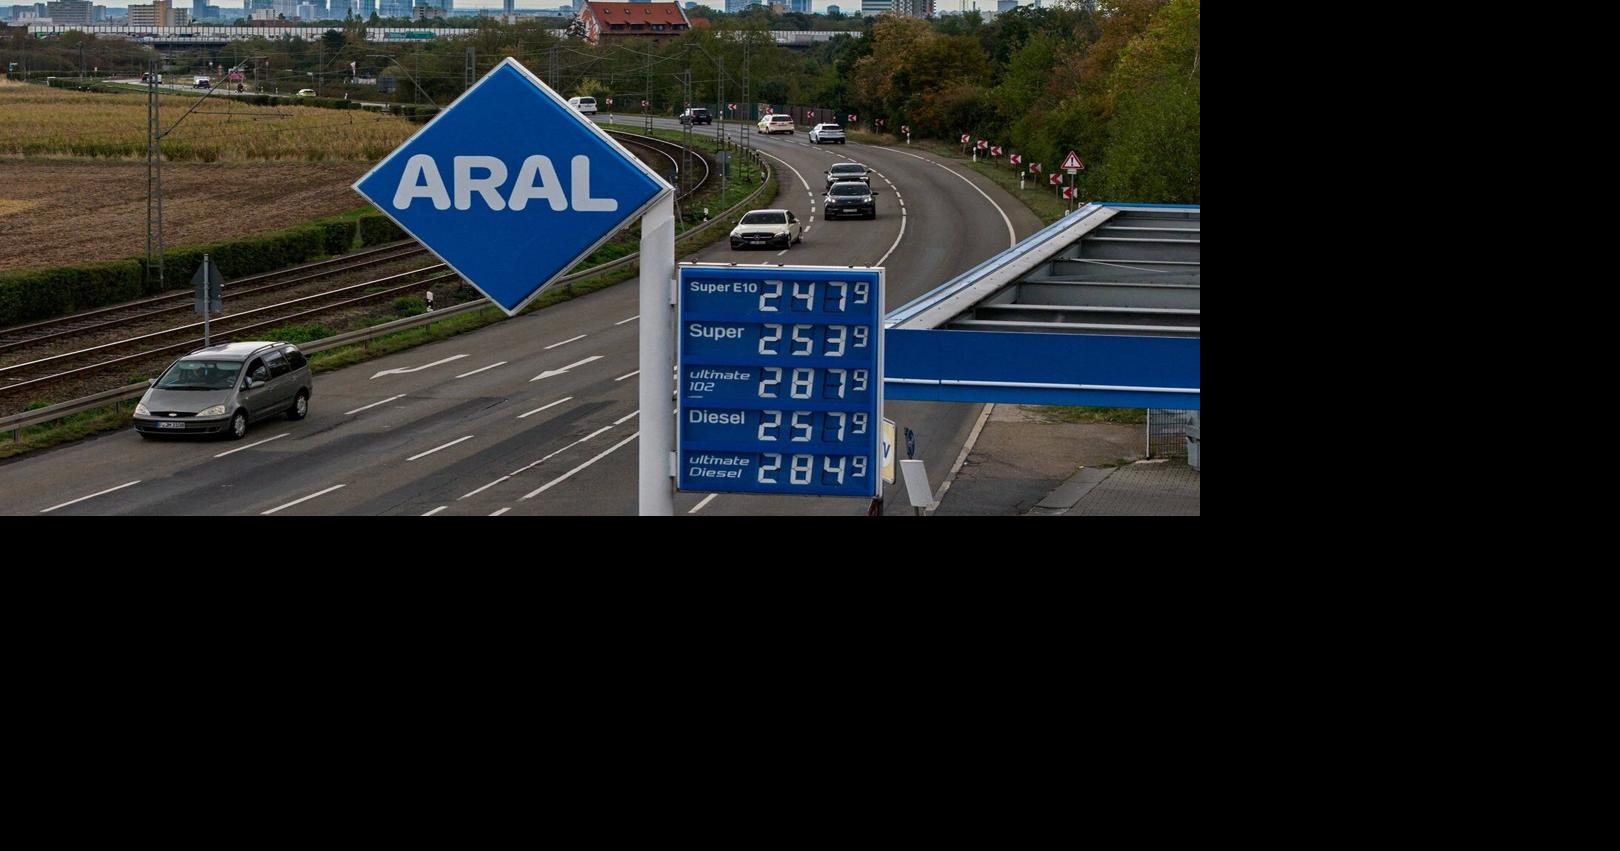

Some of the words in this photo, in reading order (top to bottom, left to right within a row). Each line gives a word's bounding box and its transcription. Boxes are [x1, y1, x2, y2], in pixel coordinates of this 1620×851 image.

[393, 154, 618, 211] ARAL
[690, 281, 730, 294] Super
[733, 283, 758, 294] E10
[690, 323, 744, 340] Super
[689, 369, 750, 381] ultimate
[689, 382, 715, 392] 102
[689, 410, 745, 424] Diesel
[689, 455, 750, 466] ultimate
[689, 467, 742, 478] Diesel
